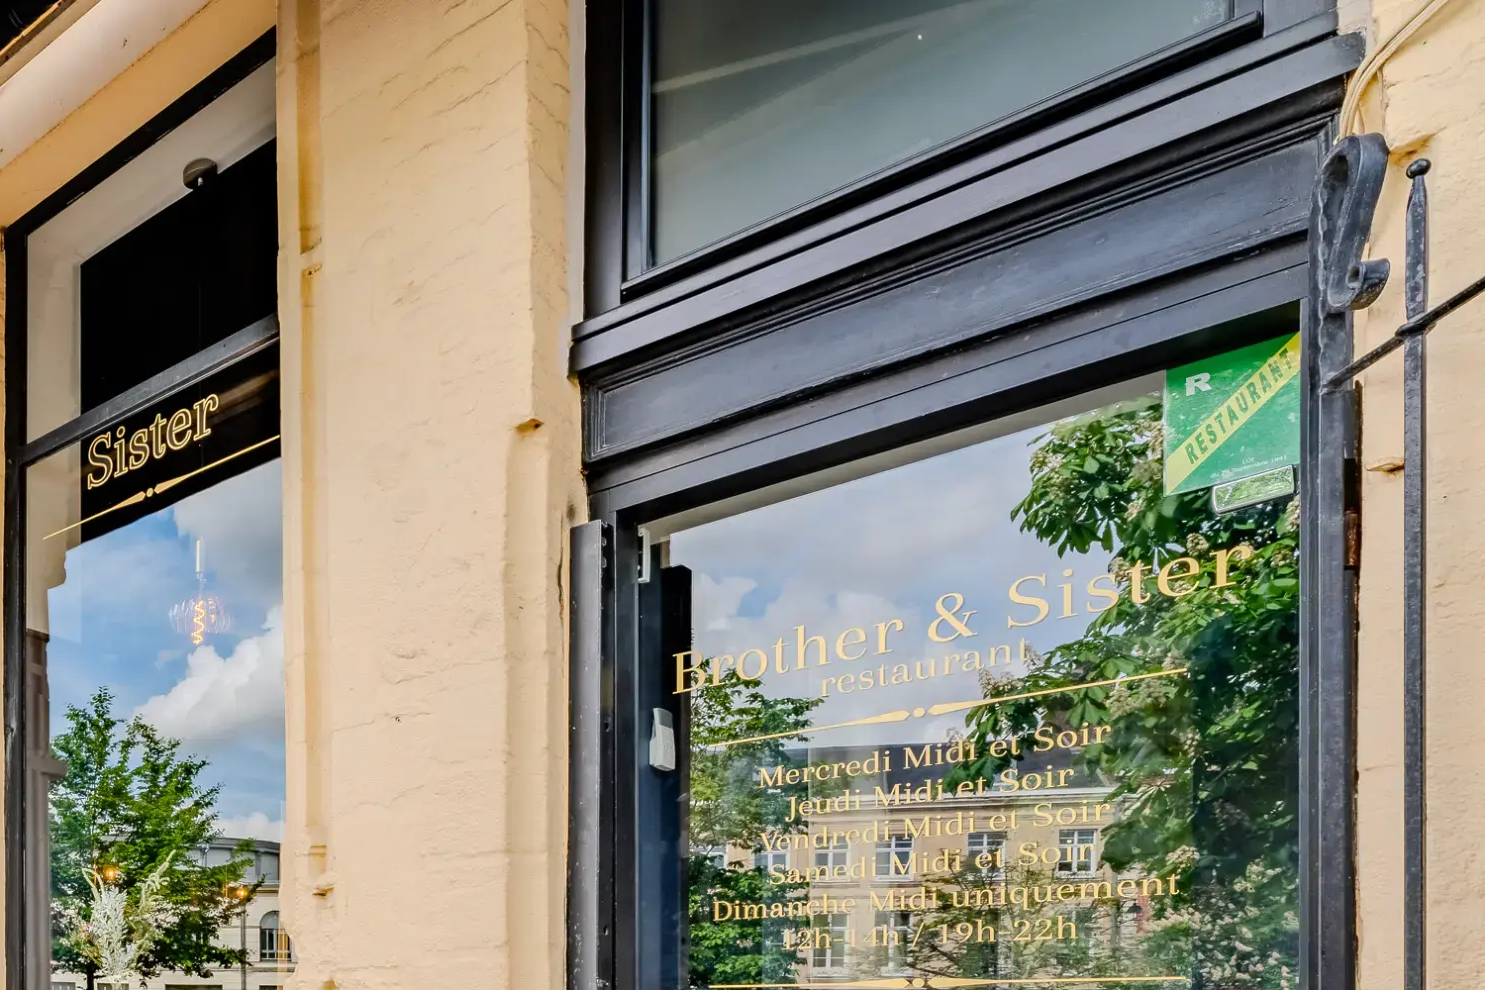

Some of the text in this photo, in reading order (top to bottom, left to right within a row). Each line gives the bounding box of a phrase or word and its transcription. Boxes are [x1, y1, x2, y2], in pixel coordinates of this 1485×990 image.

[1184, 347, 1293, 465] RESTAURANT
[1185, 371, 1213, 397] R
[86, 393, 219, 490] Sister
[672, 543, 1253, 695] Brother & Sister
[821, 636, 1030, 698] restaurant
[758, 722, 1113, 790] Mercredi Midi et Soir
[785, 764, 1075, 824] Jeudi Midi et Soir
[758, 799, 1112, 853] Vendredi Midi et Soir
[768, 838, 1095, 886] Samedi Midi et Soir
[712, 872, 1180, 922] Dimanche Midi uniquement
[781, 915, 1079, 951] 12h-14h / 19h-22h
